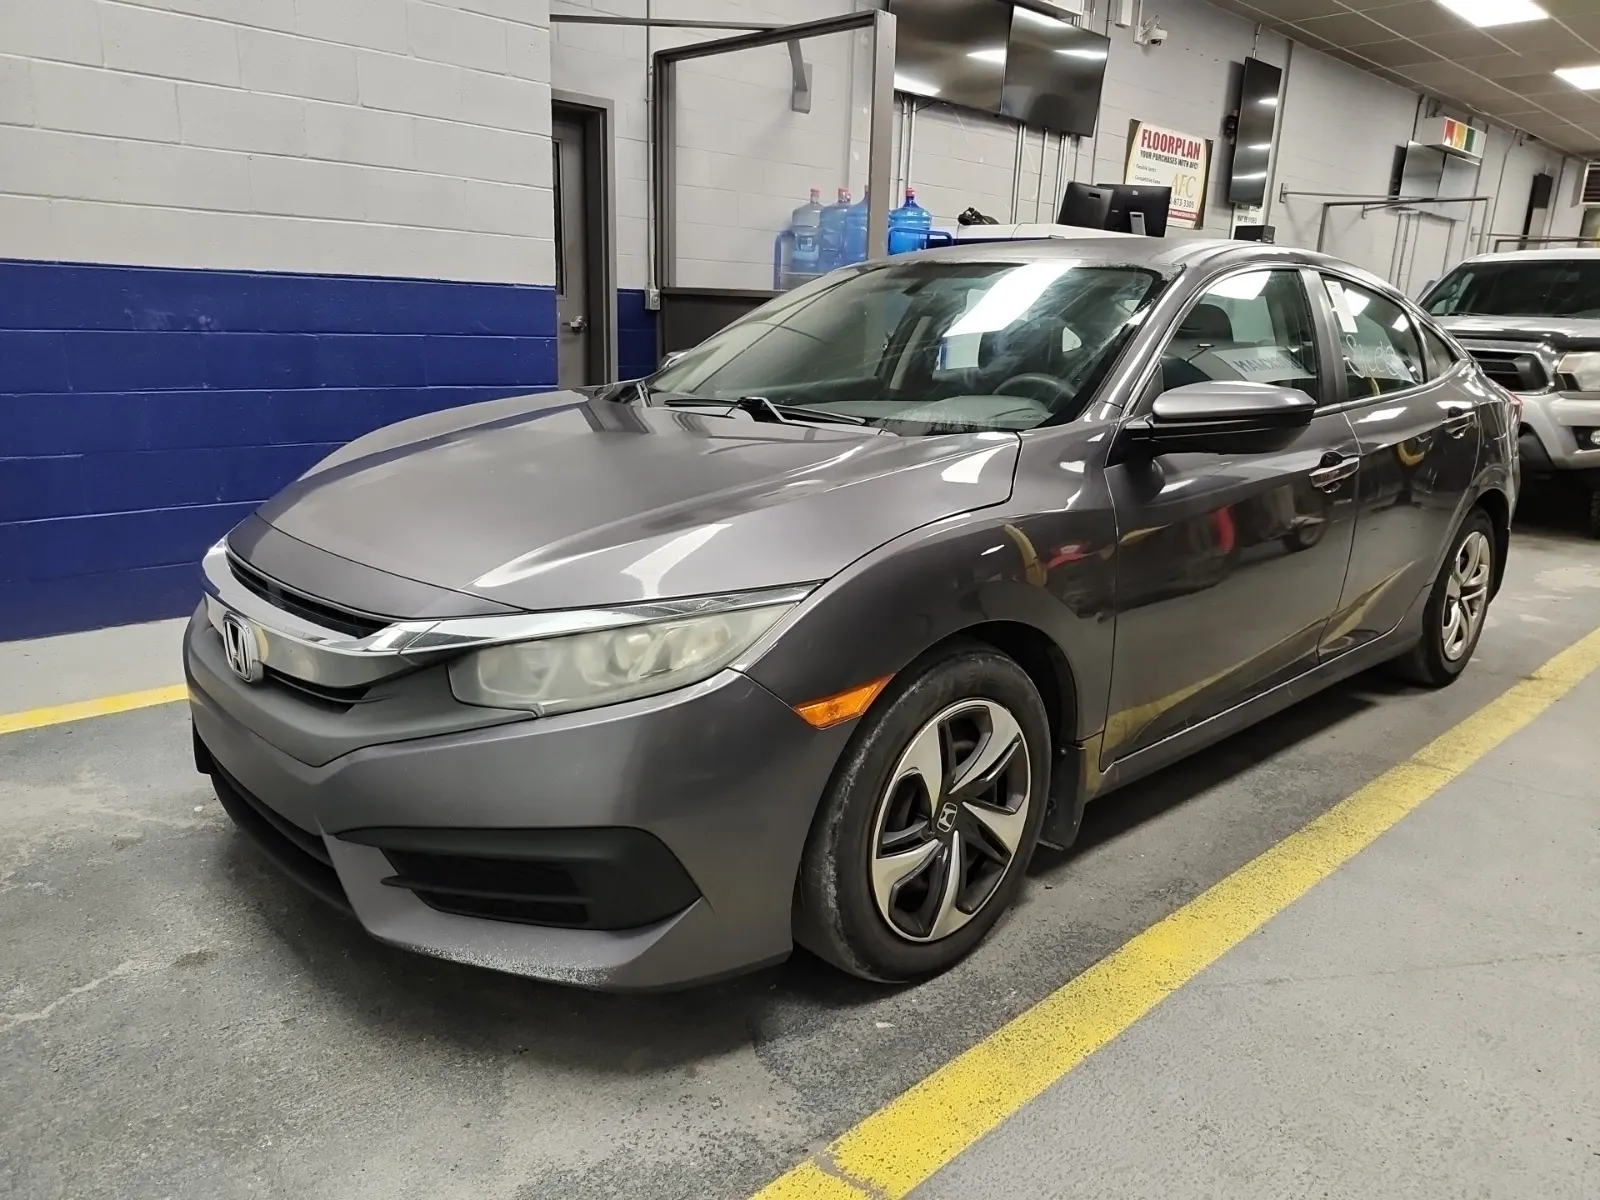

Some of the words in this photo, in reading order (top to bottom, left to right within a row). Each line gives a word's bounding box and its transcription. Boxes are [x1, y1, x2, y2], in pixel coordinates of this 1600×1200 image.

[1141, 129, 1201, 160] FLOORPLAN
[1140, 150, 1152, 159] YOUR
[1152, 152, 1177, 165] PURCHASES
[1178, 159, 1189, 168] WITH
[1172, 173, 1197, 198] AFC
